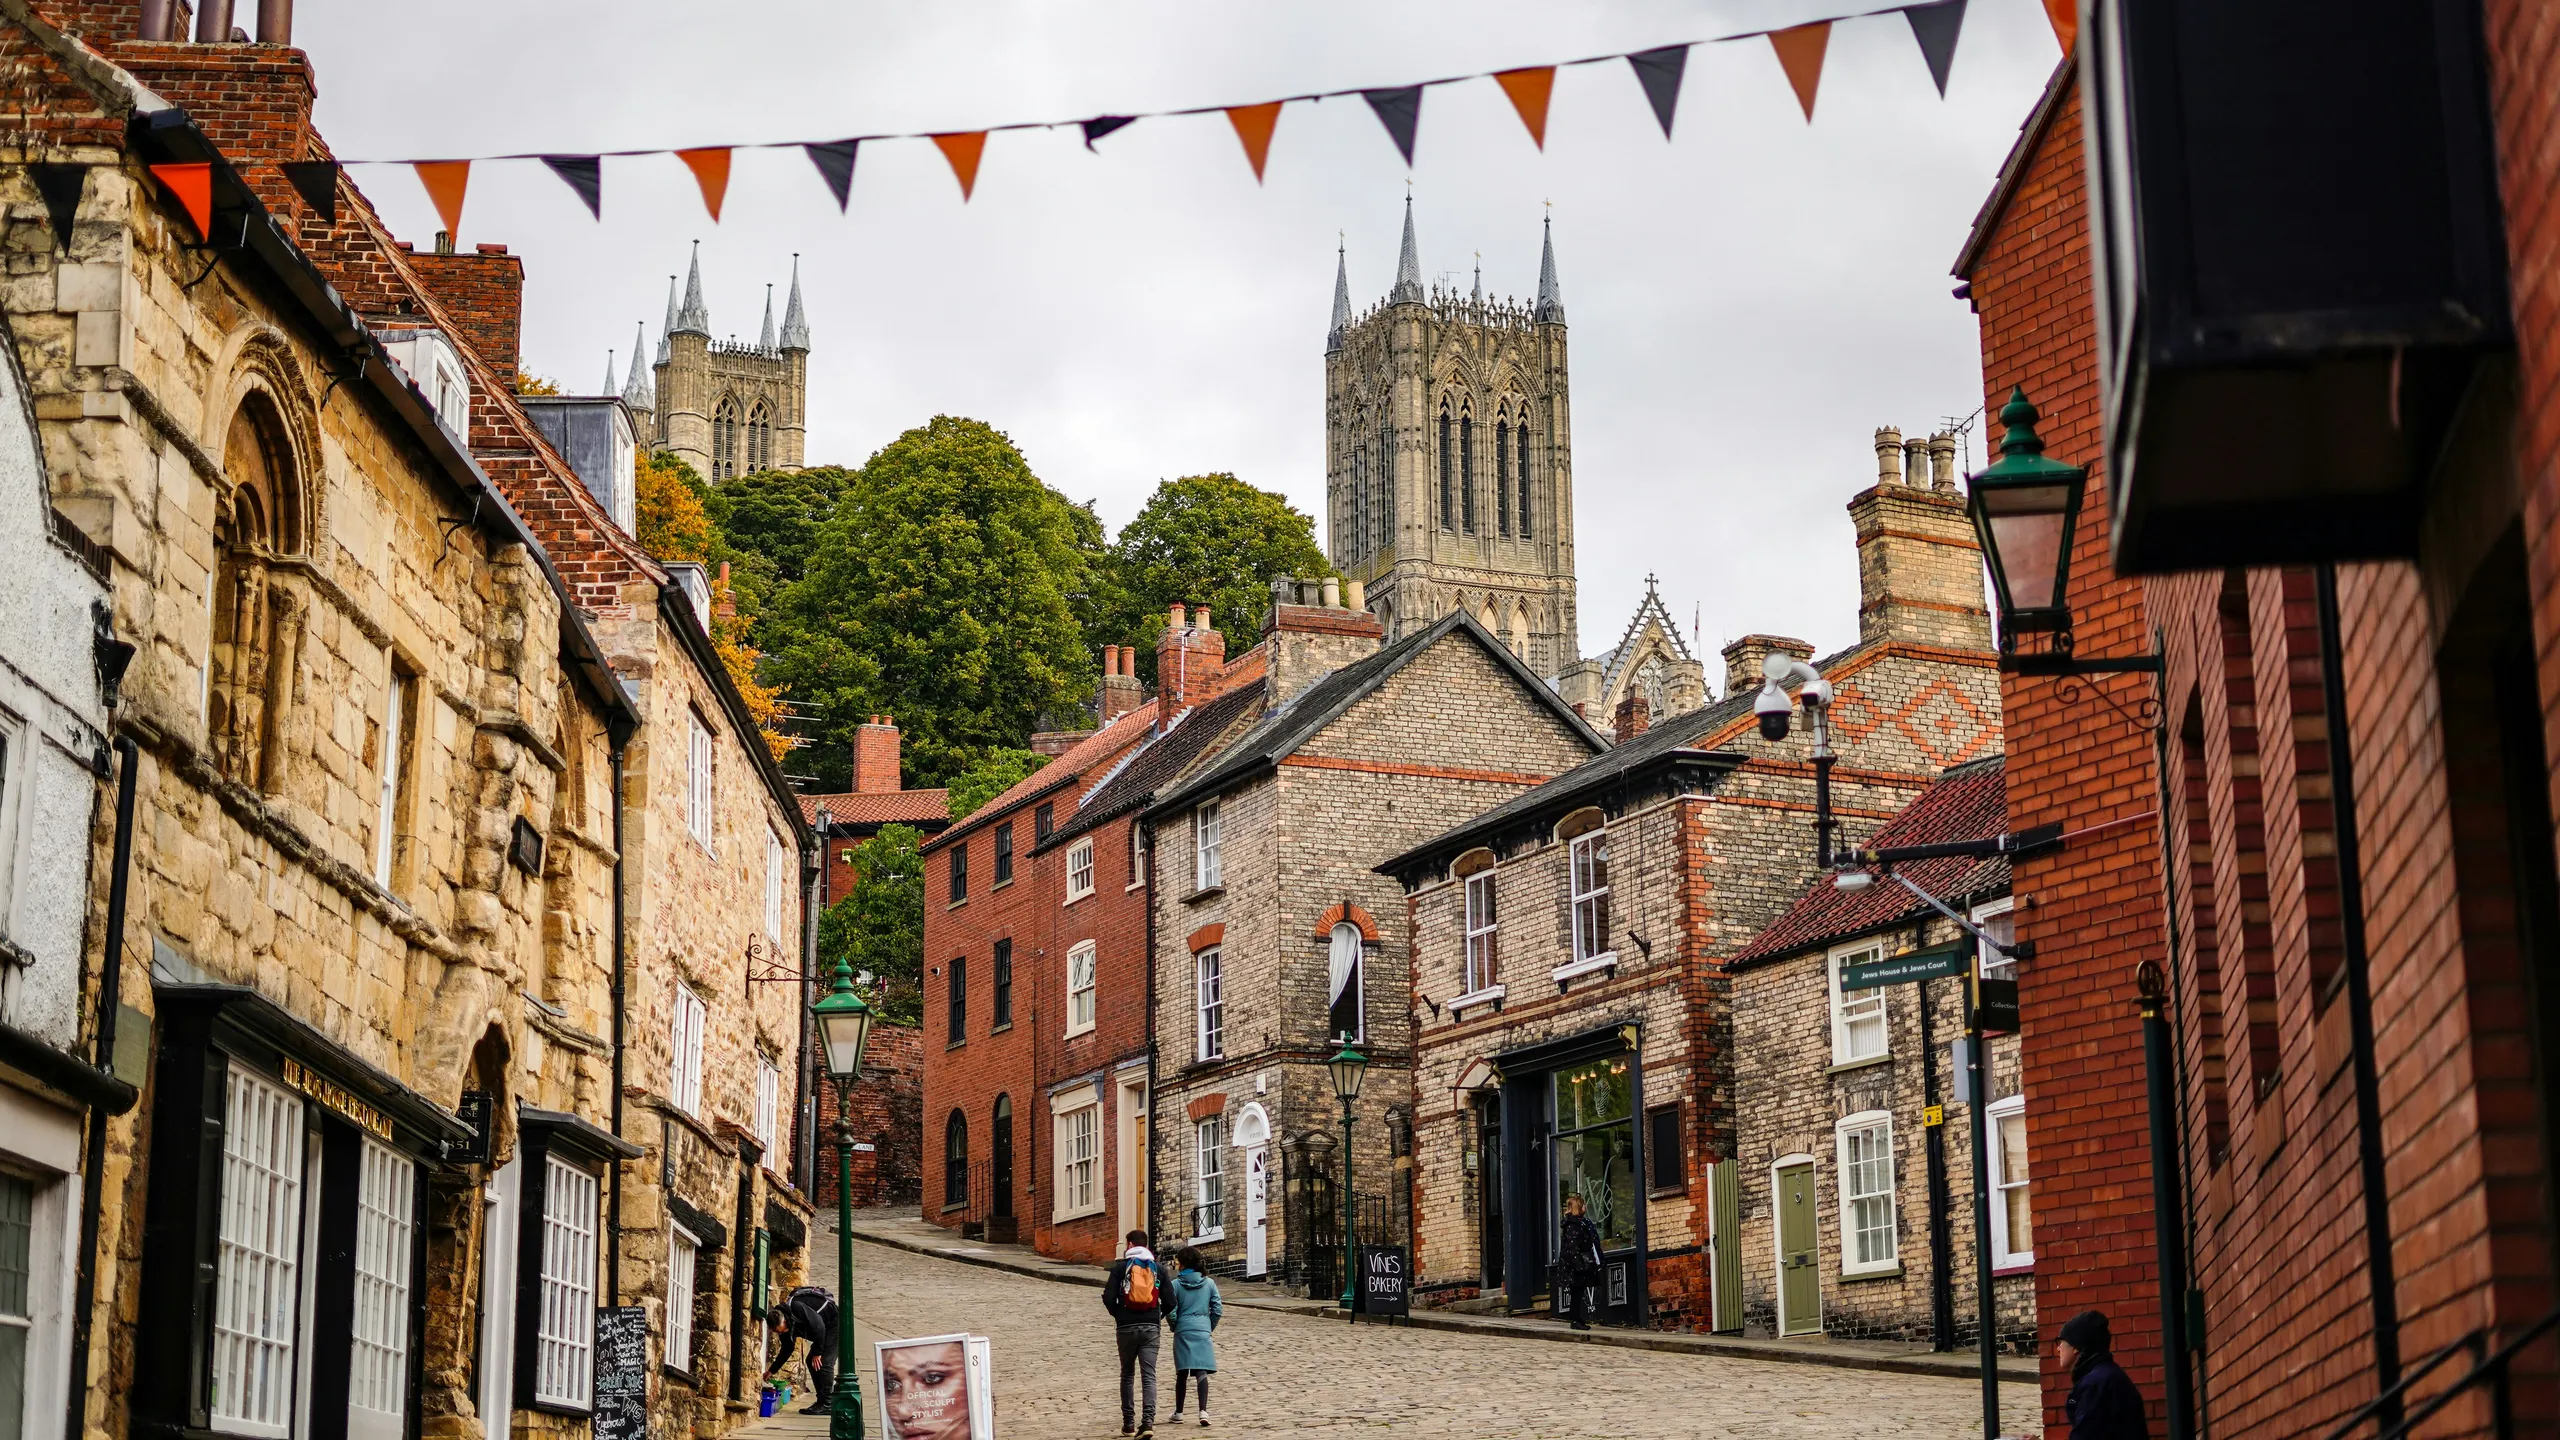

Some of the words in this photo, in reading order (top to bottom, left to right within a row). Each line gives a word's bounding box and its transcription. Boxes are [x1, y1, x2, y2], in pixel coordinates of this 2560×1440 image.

[1861, 972, 1878, 980] Jews
[1879, 968, 1901, 977] House
[1927, 961, 1947, 969] Court
[1991, 1001, 2017, 1009] Collection
[1368, 1276, 1402, 1293] BAKERY
[907, 1390, 946, 1400] OFFICIAL
[911, 1409, 944, 1419] STYLIST
